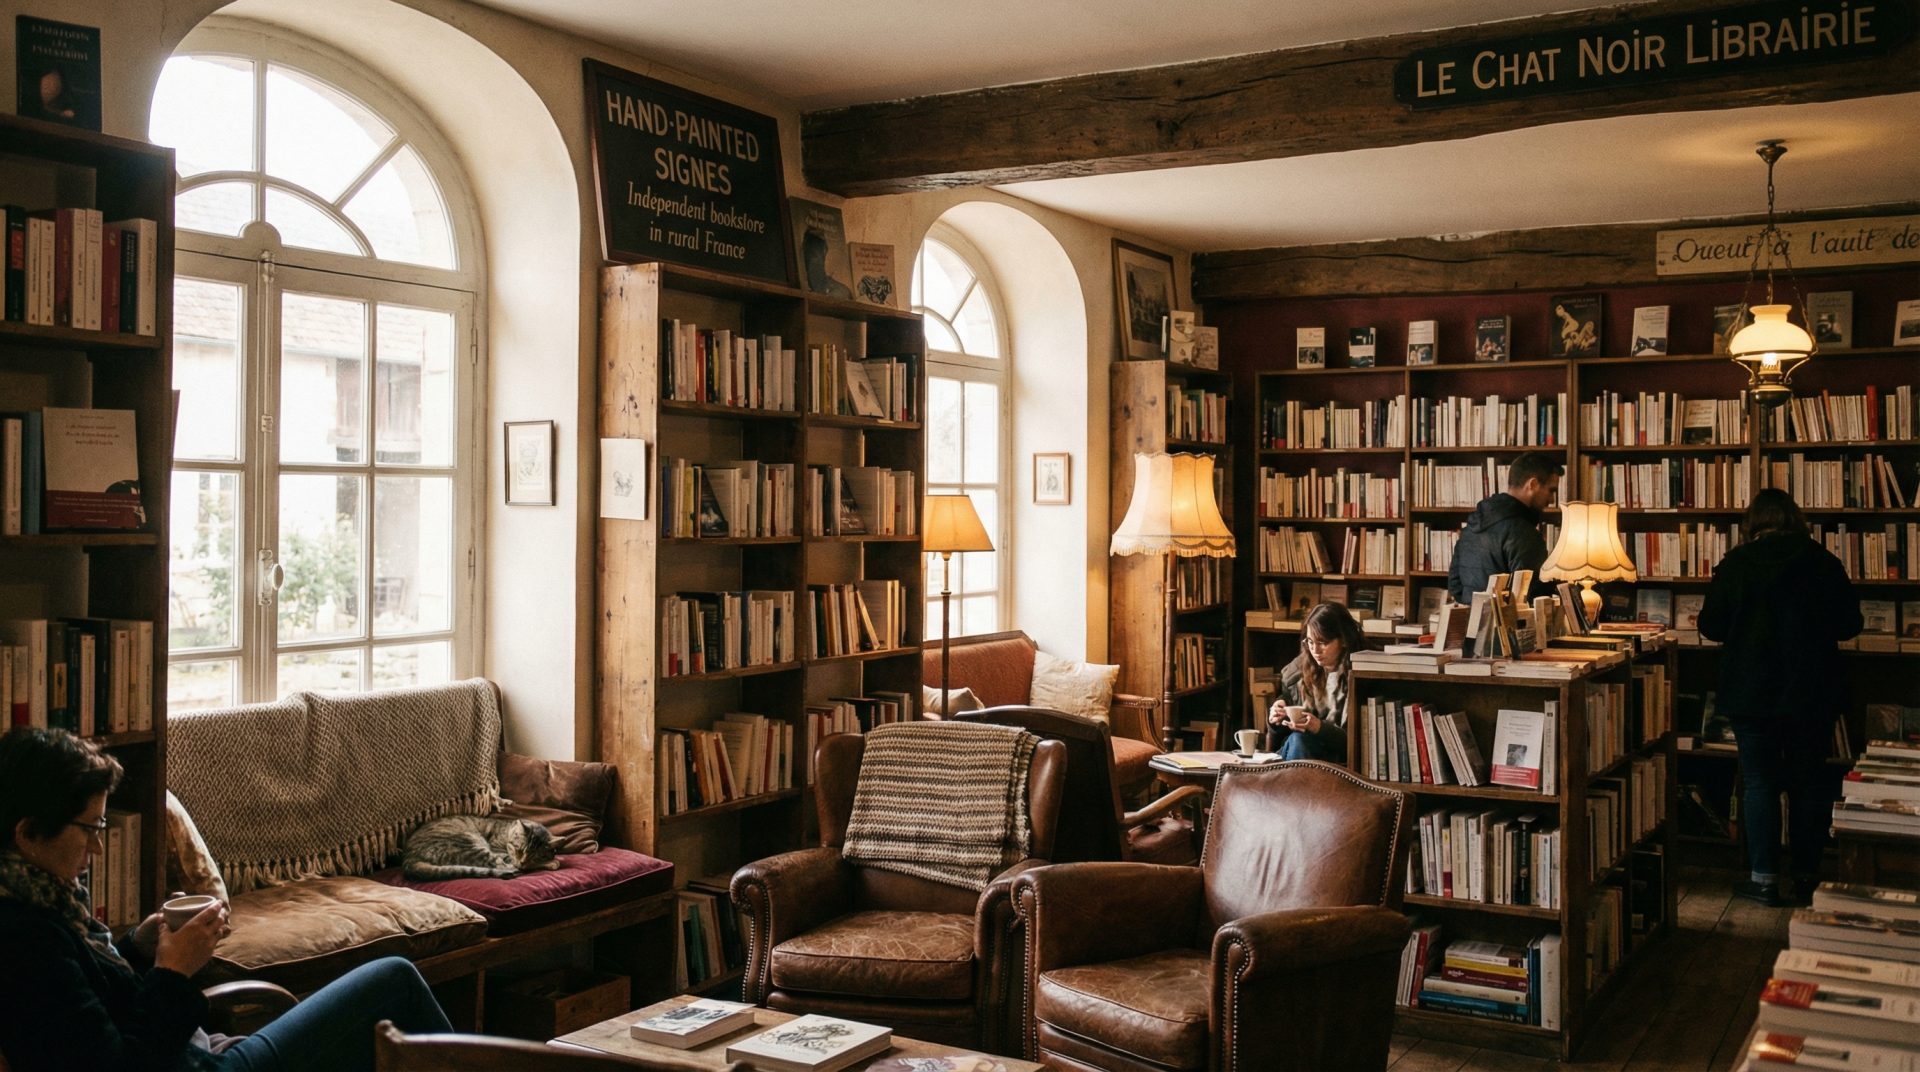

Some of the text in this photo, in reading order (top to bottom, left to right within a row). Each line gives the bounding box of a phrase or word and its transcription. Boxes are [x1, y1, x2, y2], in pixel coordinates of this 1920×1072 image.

[1416, 59, 1457, 98] LE
[1472, 47, 1562, 90] CHAT
[654, 147, 732, 196] SIGNES
[627, 181, 706, 222] Independent
[710, 206, 765, 234] bookstore
[649, 221, 746, 260] in rural France
